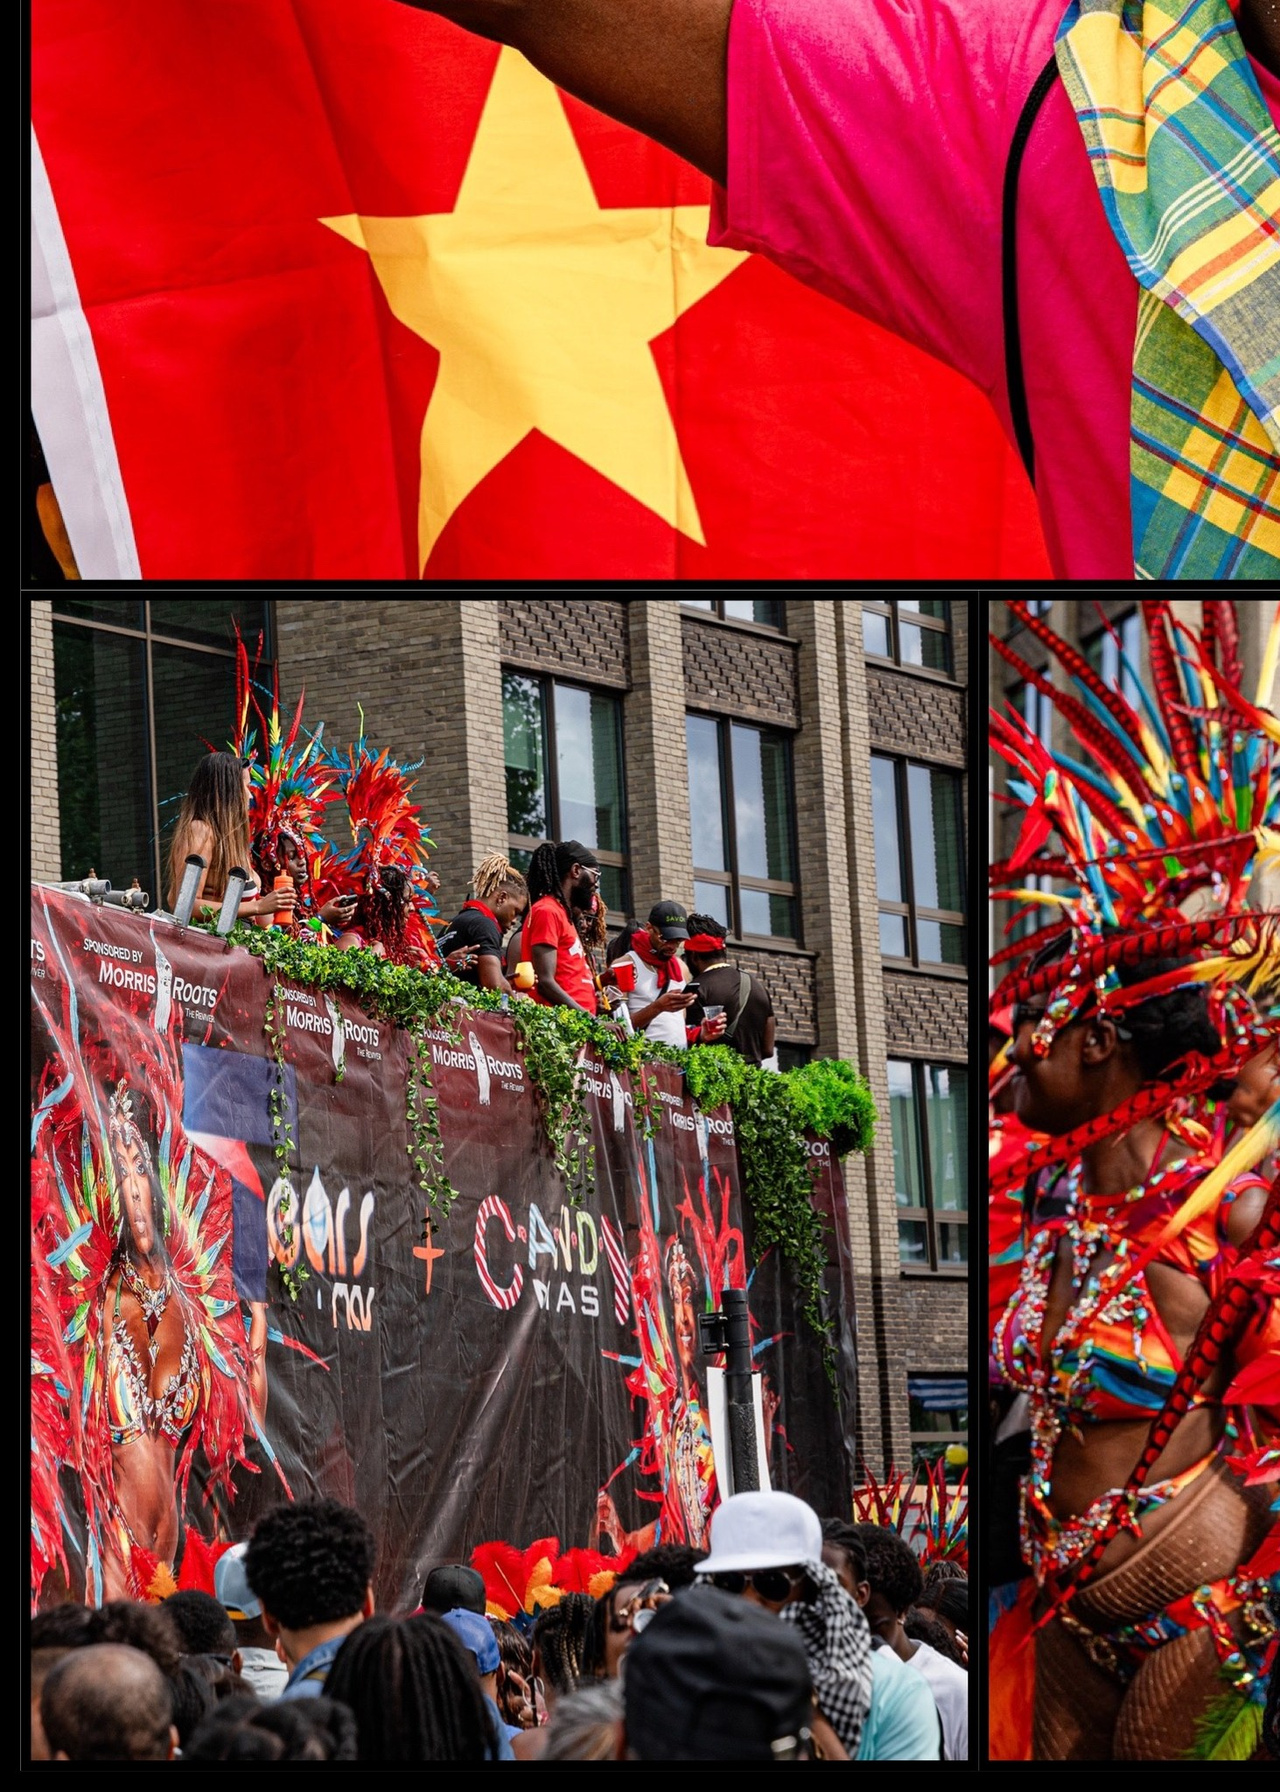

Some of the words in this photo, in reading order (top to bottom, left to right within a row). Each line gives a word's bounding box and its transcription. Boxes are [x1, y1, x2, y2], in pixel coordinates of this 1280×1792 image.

[83, 938, 131, 960] SPONSORED
[132, 949, 143, 963] BY
[98, 960, 156, 994] MORRIS
[172, 976, 218, 1008] ROOTS
[273, 985, 308, 1004] SONSORED
[185, 1008, 195, 1019] THE
[286, 1005, 332, 1035] MORRIS
[344, 1019, 380, 1047] ROOTS
[433, 1044, 475, 1071] MORRIS
[486, 1055, 523, 1080] ROOTS
